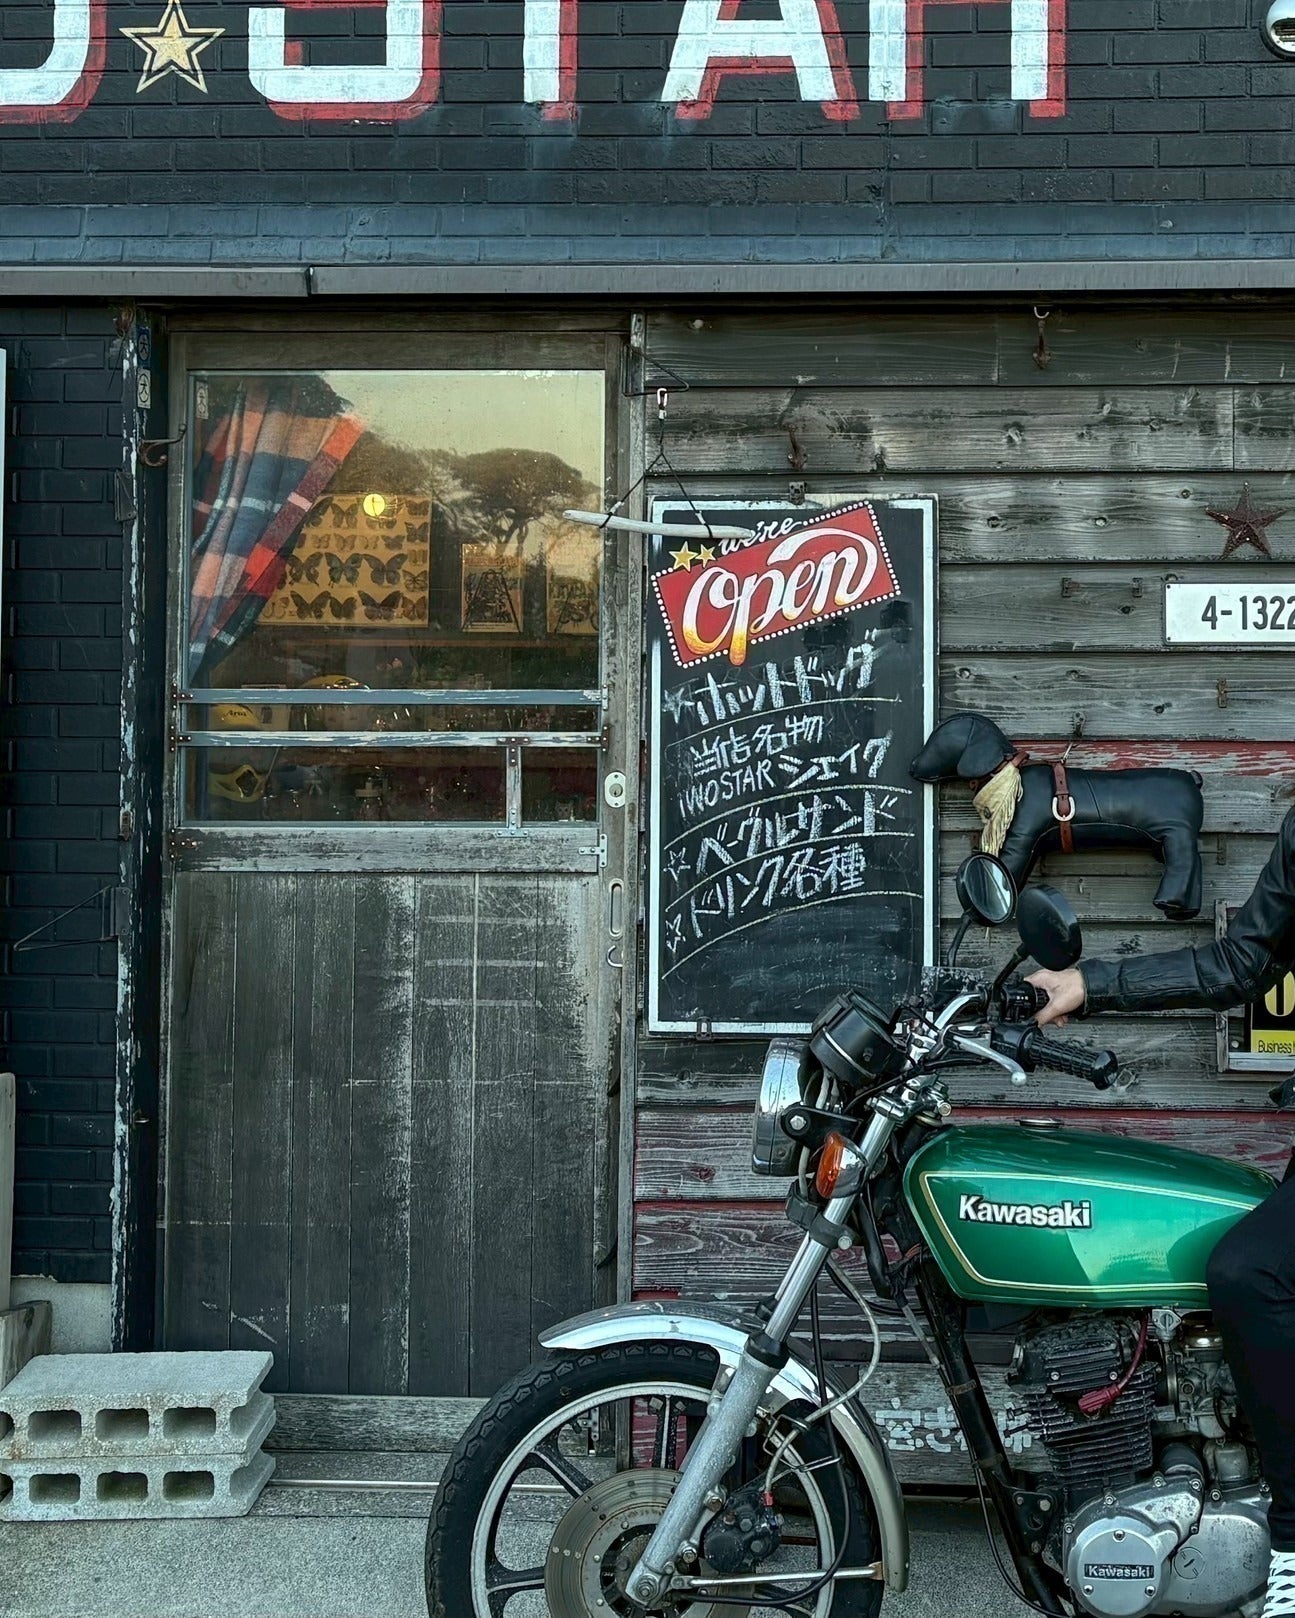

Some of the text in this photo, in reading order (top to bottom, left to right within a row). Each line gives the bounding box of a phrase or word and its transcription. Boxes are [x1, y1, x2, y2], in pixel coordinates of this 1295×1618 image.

[683, 527, 877, 666] Open
[694, 628, 878, 726] ホットドッグ
[690, 714, 825, 777] 当店名物
[777, 729, 893, 790] シェイク
[696, 790, 899, 876] ベーグルサンド
[690, 842, 867, 940] ドリンク各種
[1258, 1039, 1292, 1054] Business
[959, 1194, 1091, 1228] Kawasaki
[1088, 1564, 1151, 1578] Kawasaki
